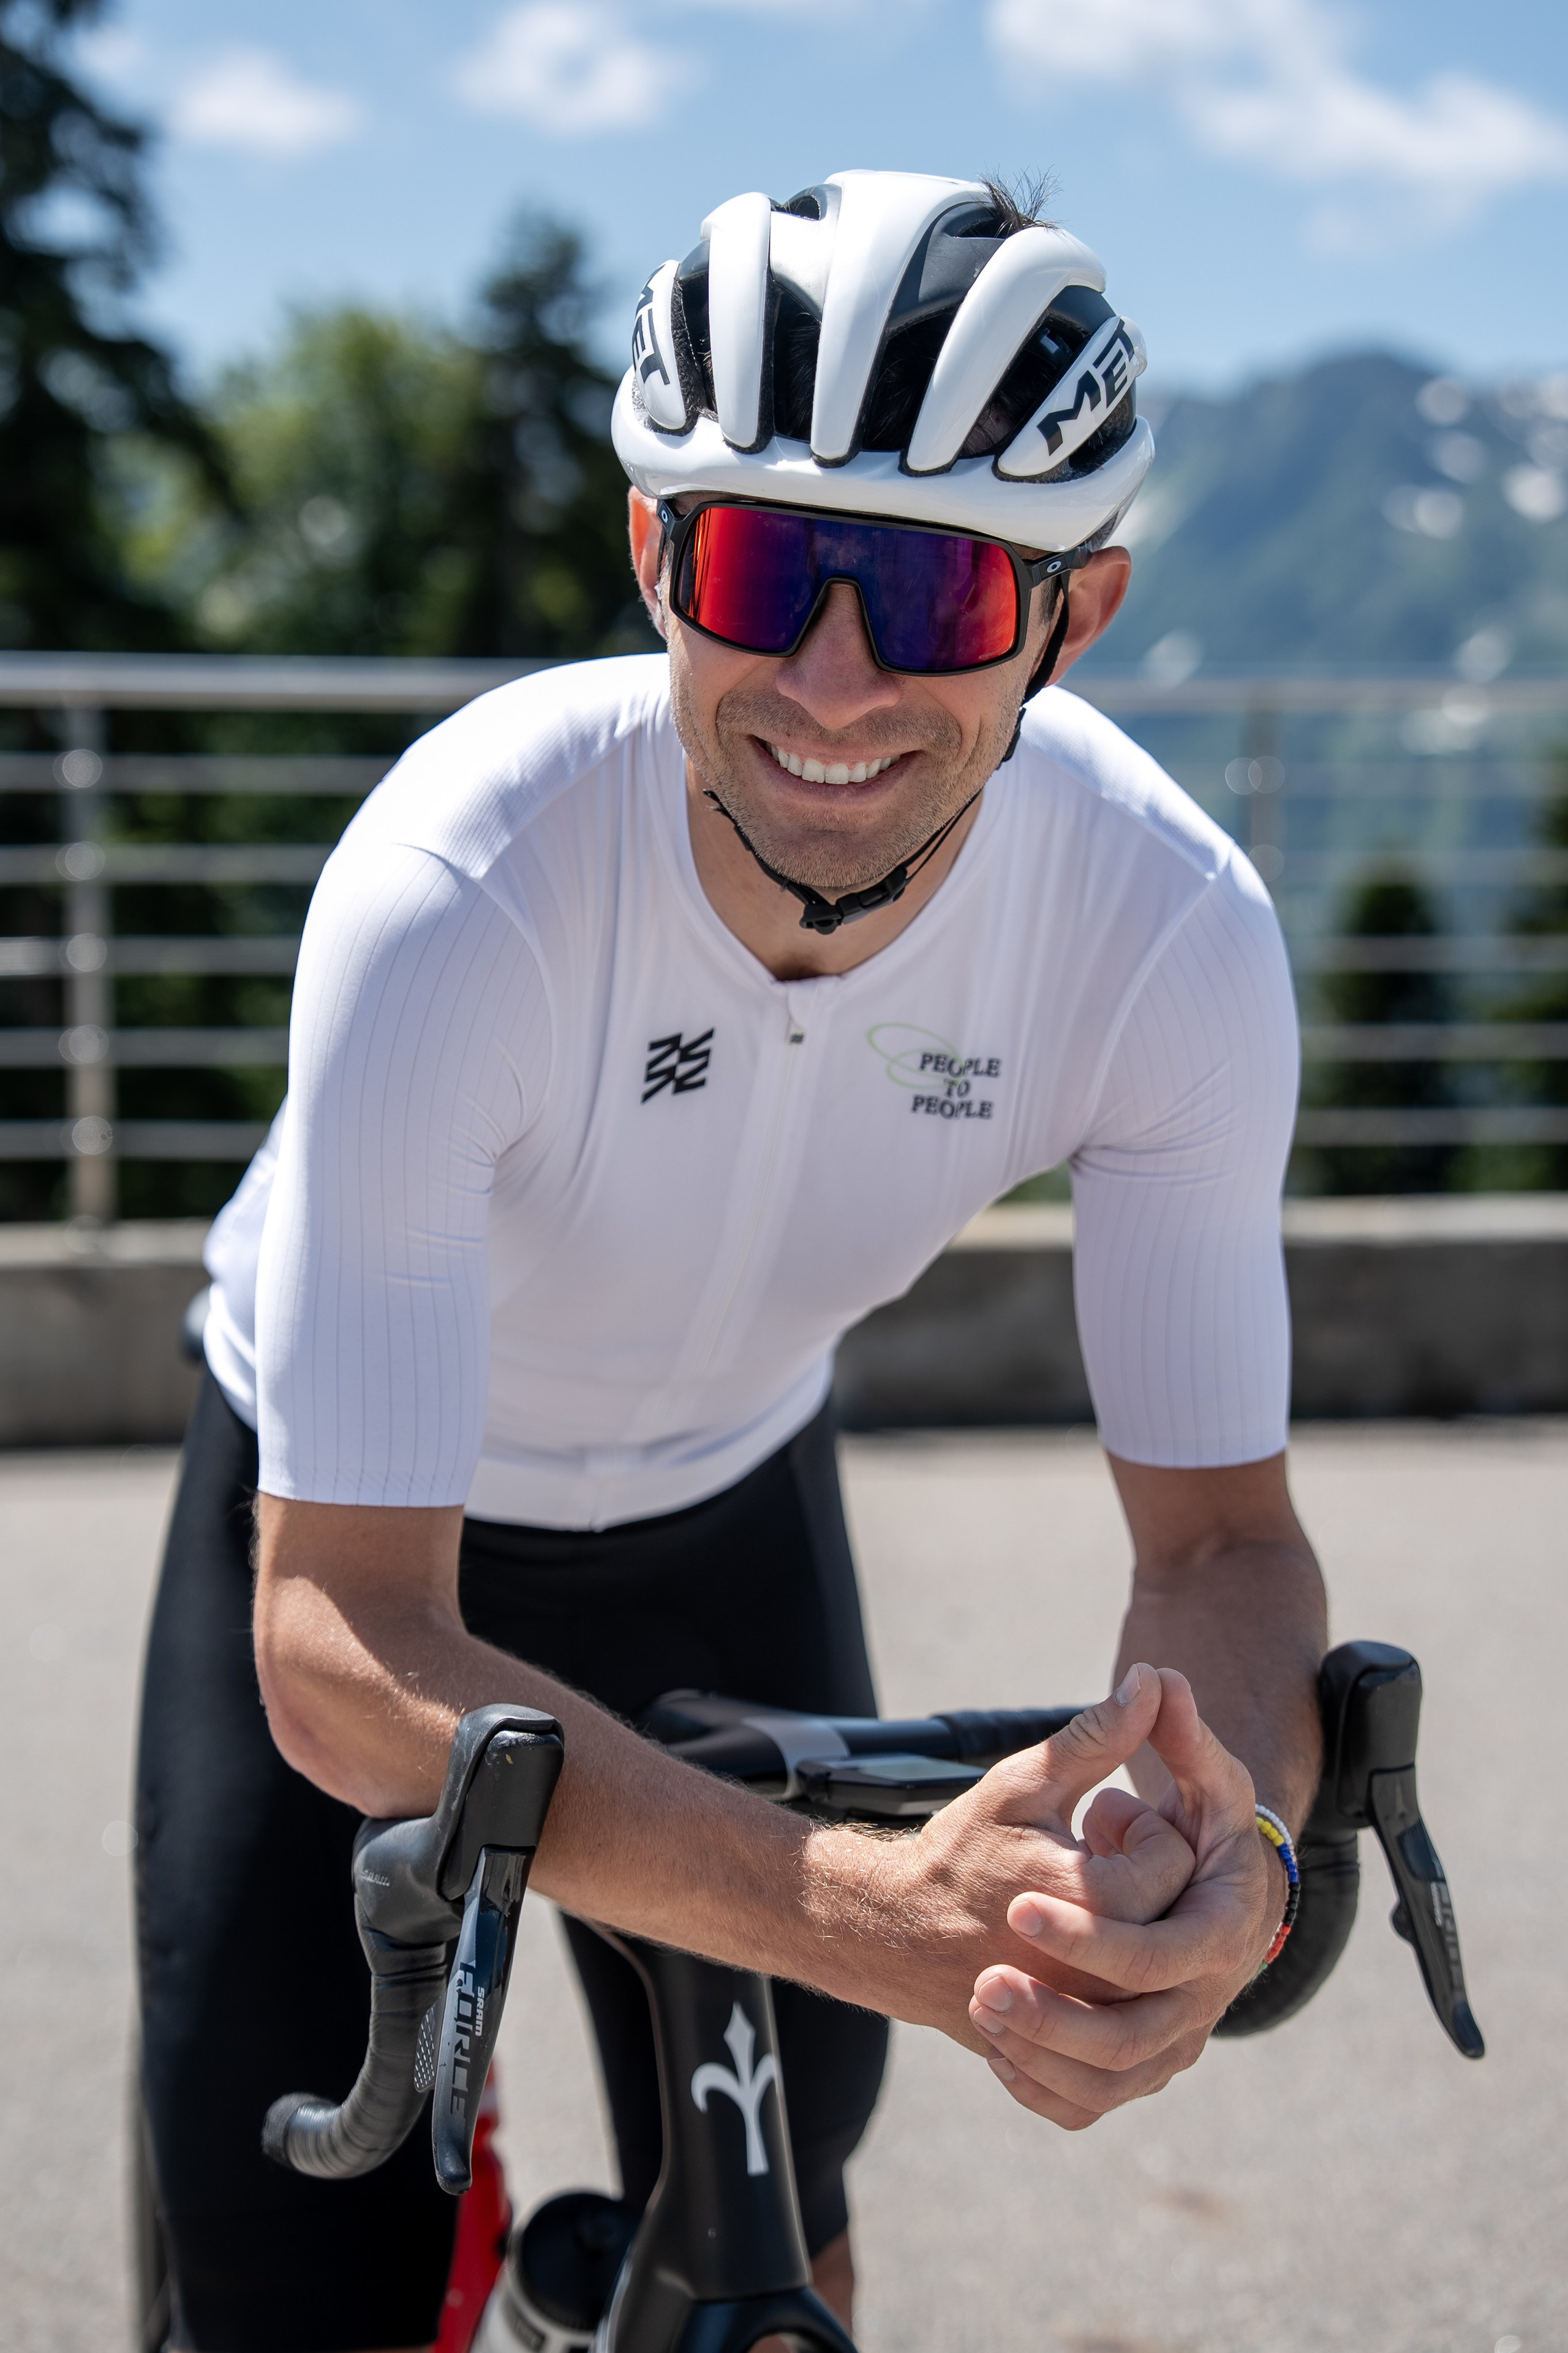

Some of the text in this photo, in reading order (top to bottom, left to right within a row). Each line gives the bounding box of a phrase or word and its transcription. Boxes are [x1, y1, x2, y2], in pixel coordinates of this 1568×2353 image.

[1036, 318, 1135, 457] MET
[919, 1052, 1002, 1078] PEOPLE
[943, 1078, 971, 1098] TO
[910, 1095, 993, 1120] PEOPLE
[475, 1986, 485, 2037] SRAM
[450, 1961, 476, 2120] FORCE
